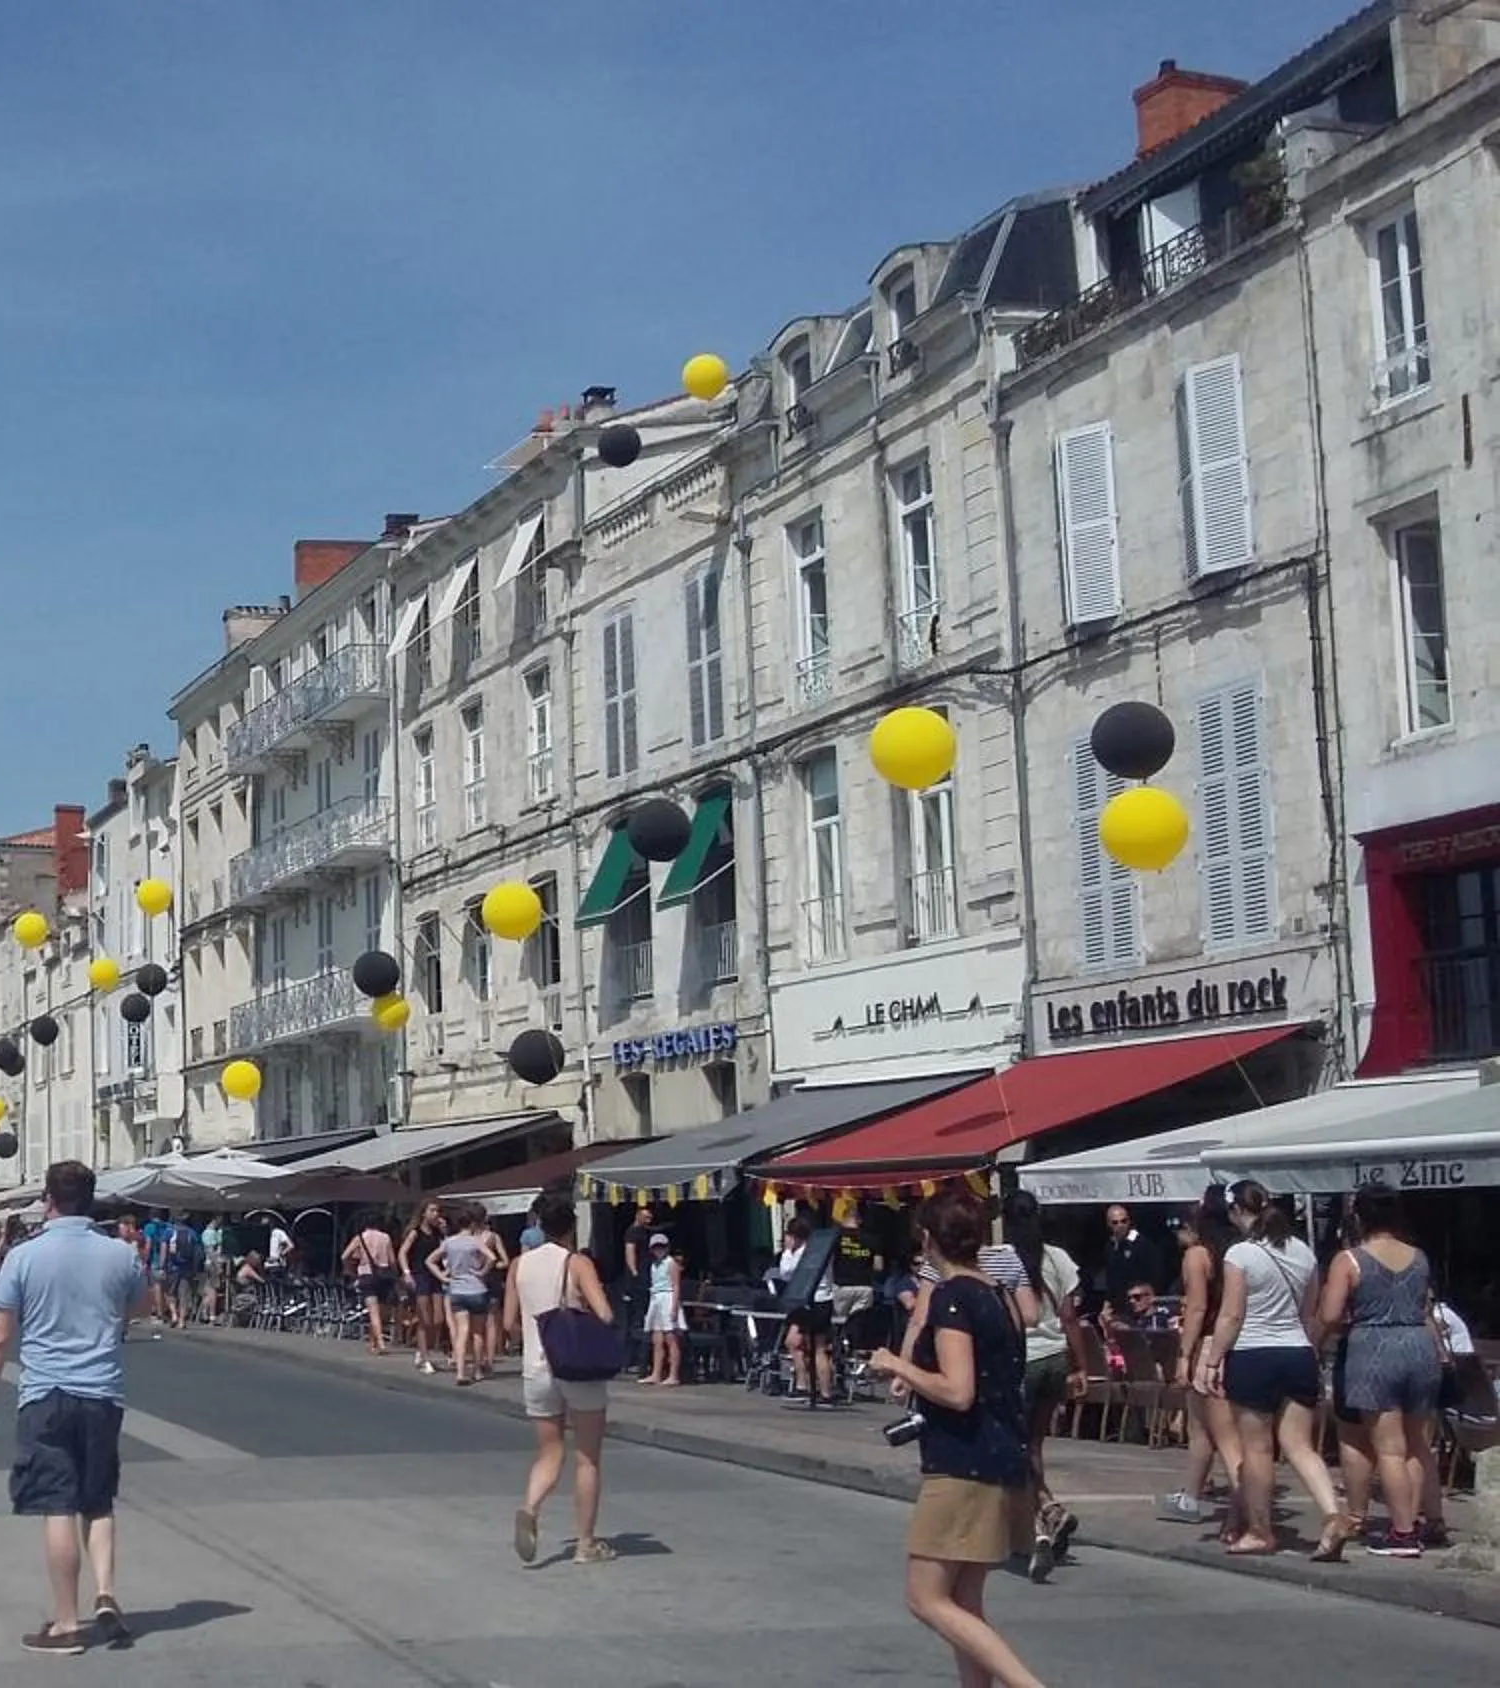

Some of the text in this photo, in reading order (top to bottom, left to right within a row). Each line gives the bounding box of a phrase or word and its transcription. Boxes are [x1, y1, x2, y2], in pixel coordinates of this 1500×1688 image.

[866, 1002, 885, 1026] LE
[1047, 967, 1288, 1038] Les enfants du rock
[1128, 1173, 1165, 1197] PUB
[1353, 1158, 1465, 1189] Le Zinc
